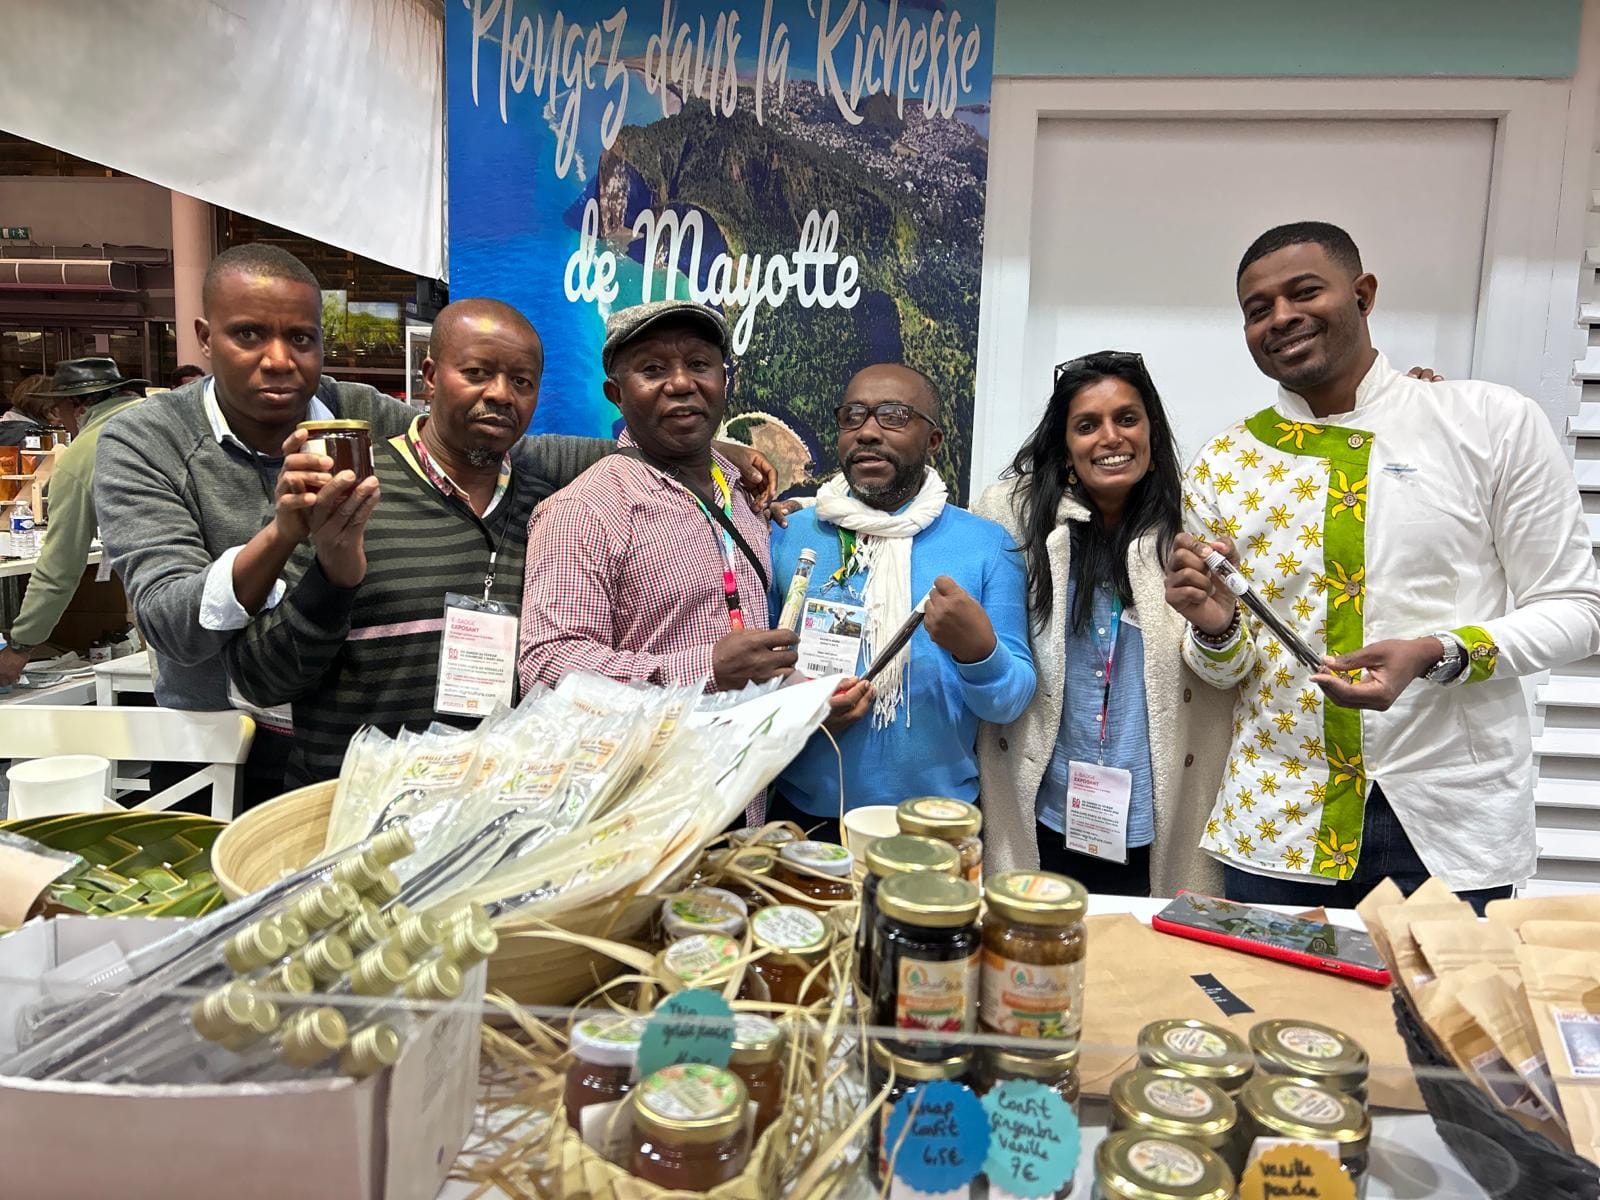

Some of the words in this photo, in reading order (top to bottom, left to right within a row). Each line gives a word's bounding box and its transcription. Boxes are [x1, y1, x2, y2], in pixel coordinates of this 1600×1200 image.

[646, 0, 741, 118] dans
[755, 0, 792, 126] la
[808, 0, 982, 126] Richesse
[564, 198, 620, 304] de
[631, 208, 862, 356] Mayotte
[451, 623, 480, 633] EXPOSANT
[1074, 777, 1100, 787] EXPOSANT
